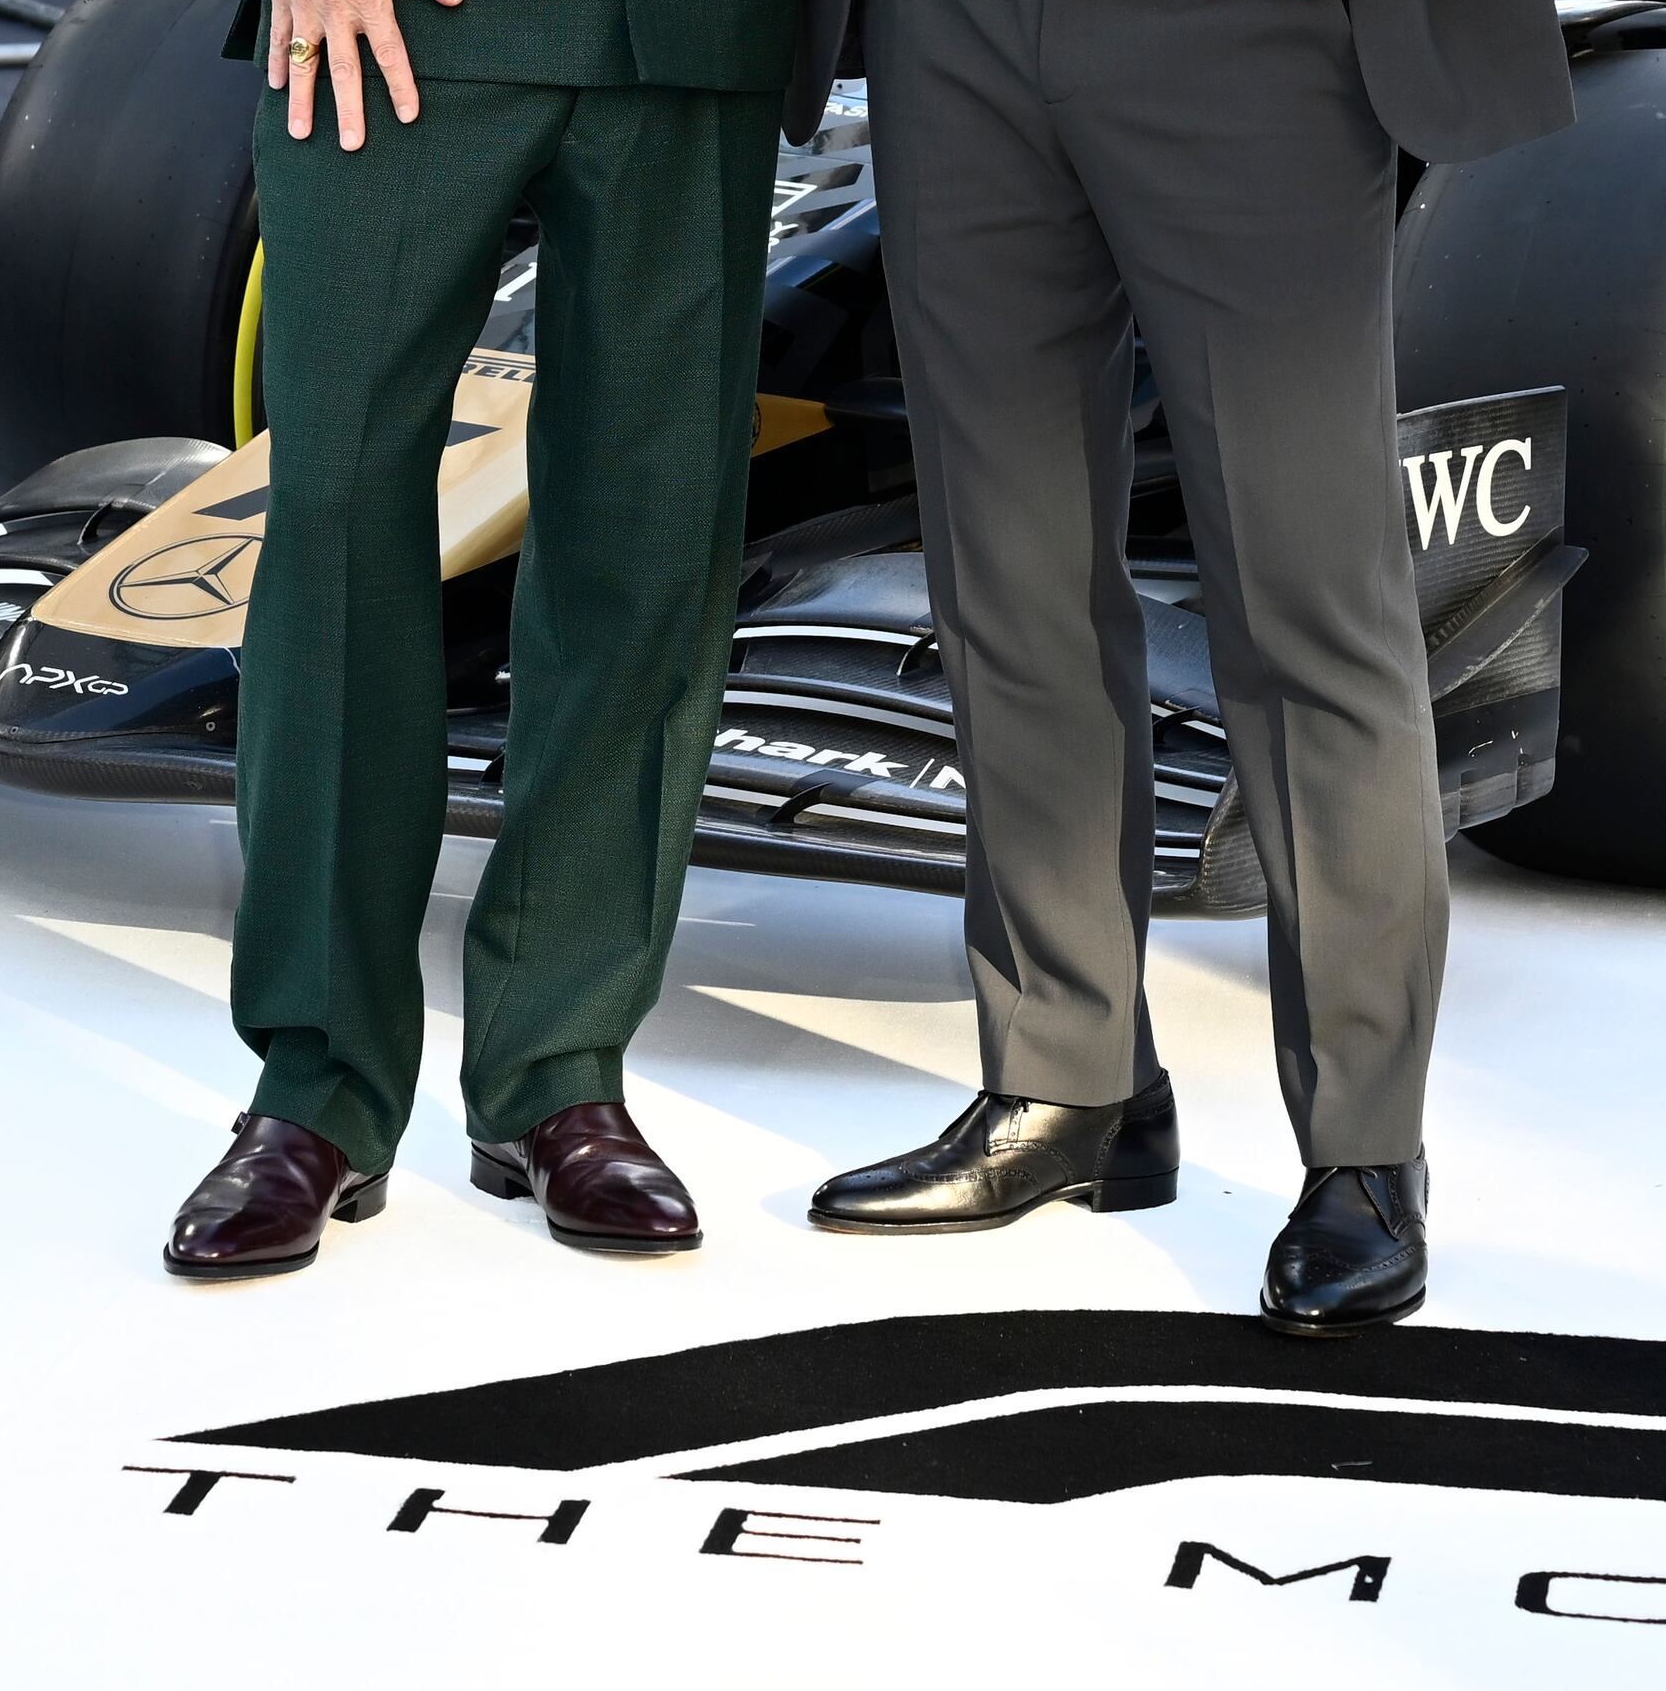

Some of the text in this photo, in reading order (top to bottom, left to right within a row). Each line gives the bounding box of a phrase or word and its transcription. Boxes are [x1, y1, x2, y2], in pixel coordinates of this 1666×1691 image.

[1399, 436, 1532, 551] WC
[715, 728, 910, 778] hark
[123, 1464, 881, 1565] THE
